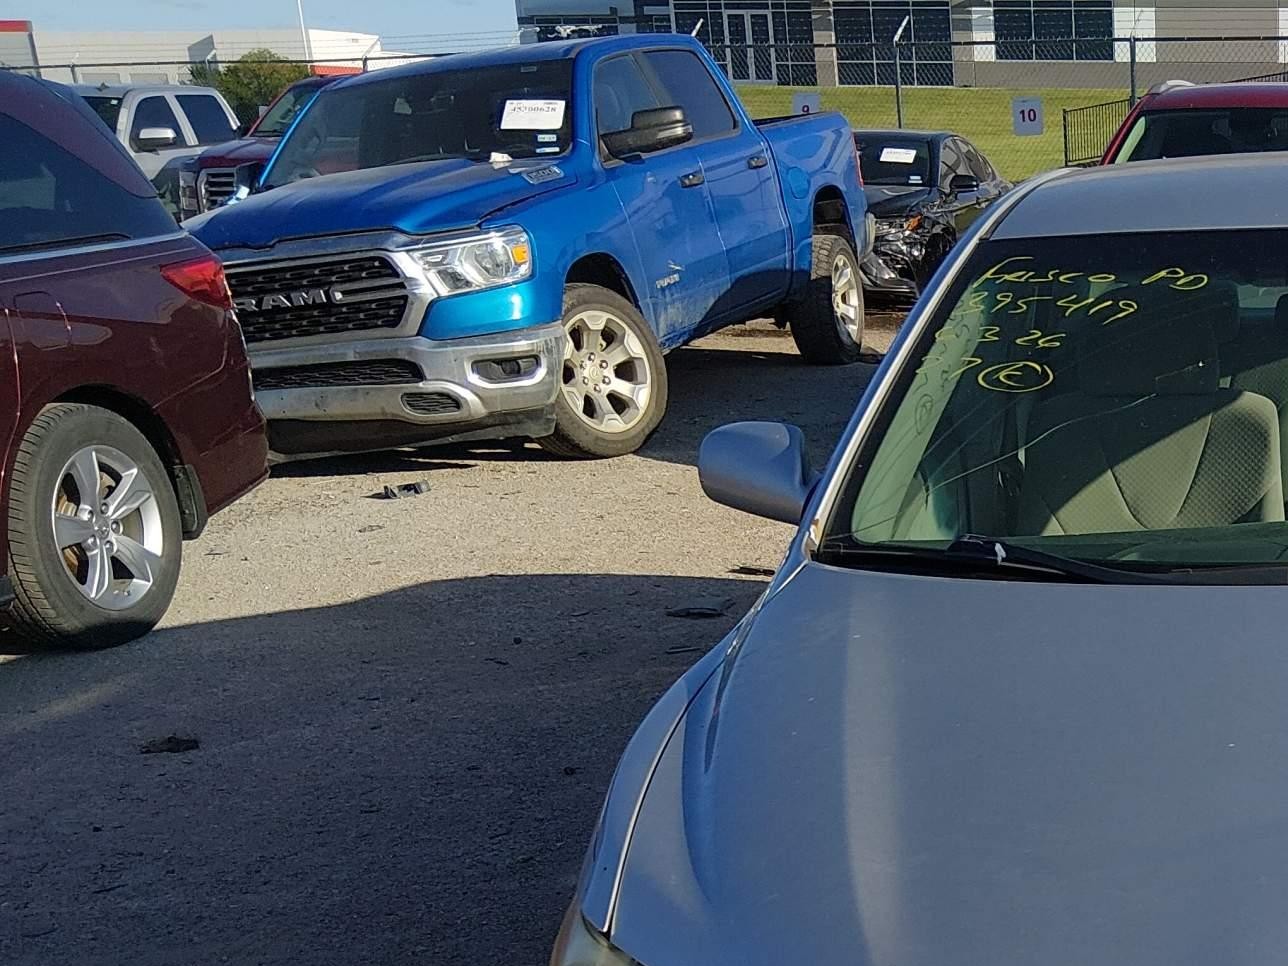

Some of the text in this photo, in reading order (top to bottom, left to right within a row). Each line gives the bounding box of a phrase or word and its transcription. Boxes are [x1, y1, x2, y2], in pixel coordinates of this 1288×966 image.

[1019, 108, 1037, 122] 10
[1141, 267, 1209, 291] PD
[234, 288, 327, 312] RAM
[1014, 329, 1068, 349] 26
